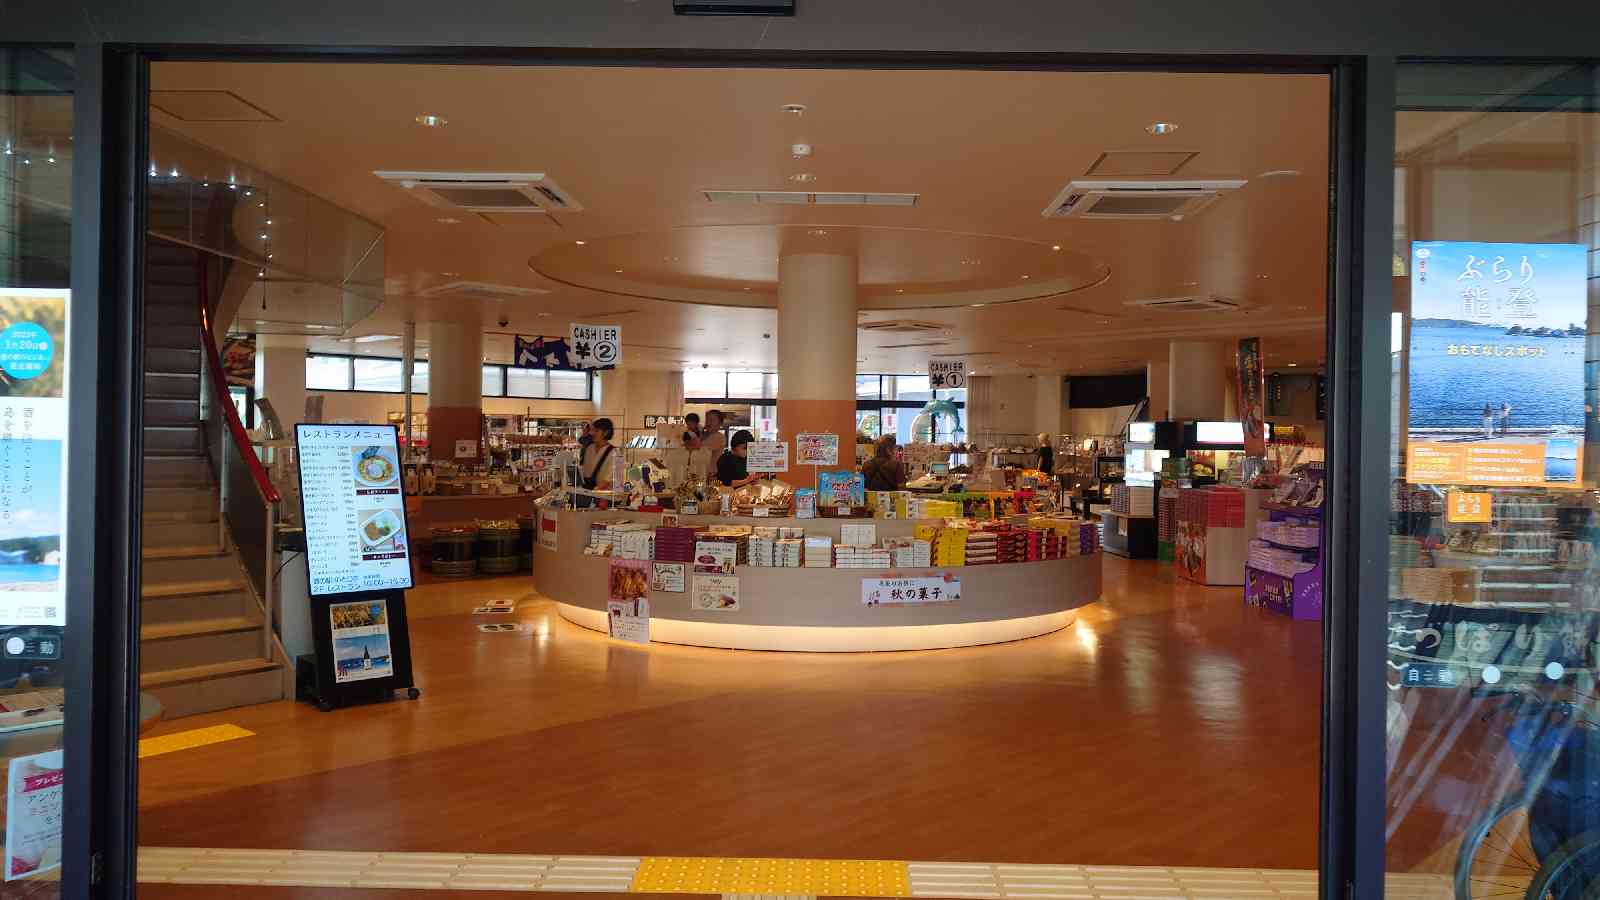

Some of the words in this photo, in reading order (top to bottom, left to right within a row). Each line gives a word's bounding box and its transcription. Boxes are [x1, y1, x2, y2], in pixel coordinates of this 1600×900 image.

[1457, 255, 1535, 286] ぶらり
[574, 327, 617, 340] CASHIER
[1447, 344, 1546, 358] おもてなしスポット
[931, 362, 963, 372] CASHIER
[303, 429, 393, 439] レストランメニュー
[891, 587, 942, 600] 秋の菓子
